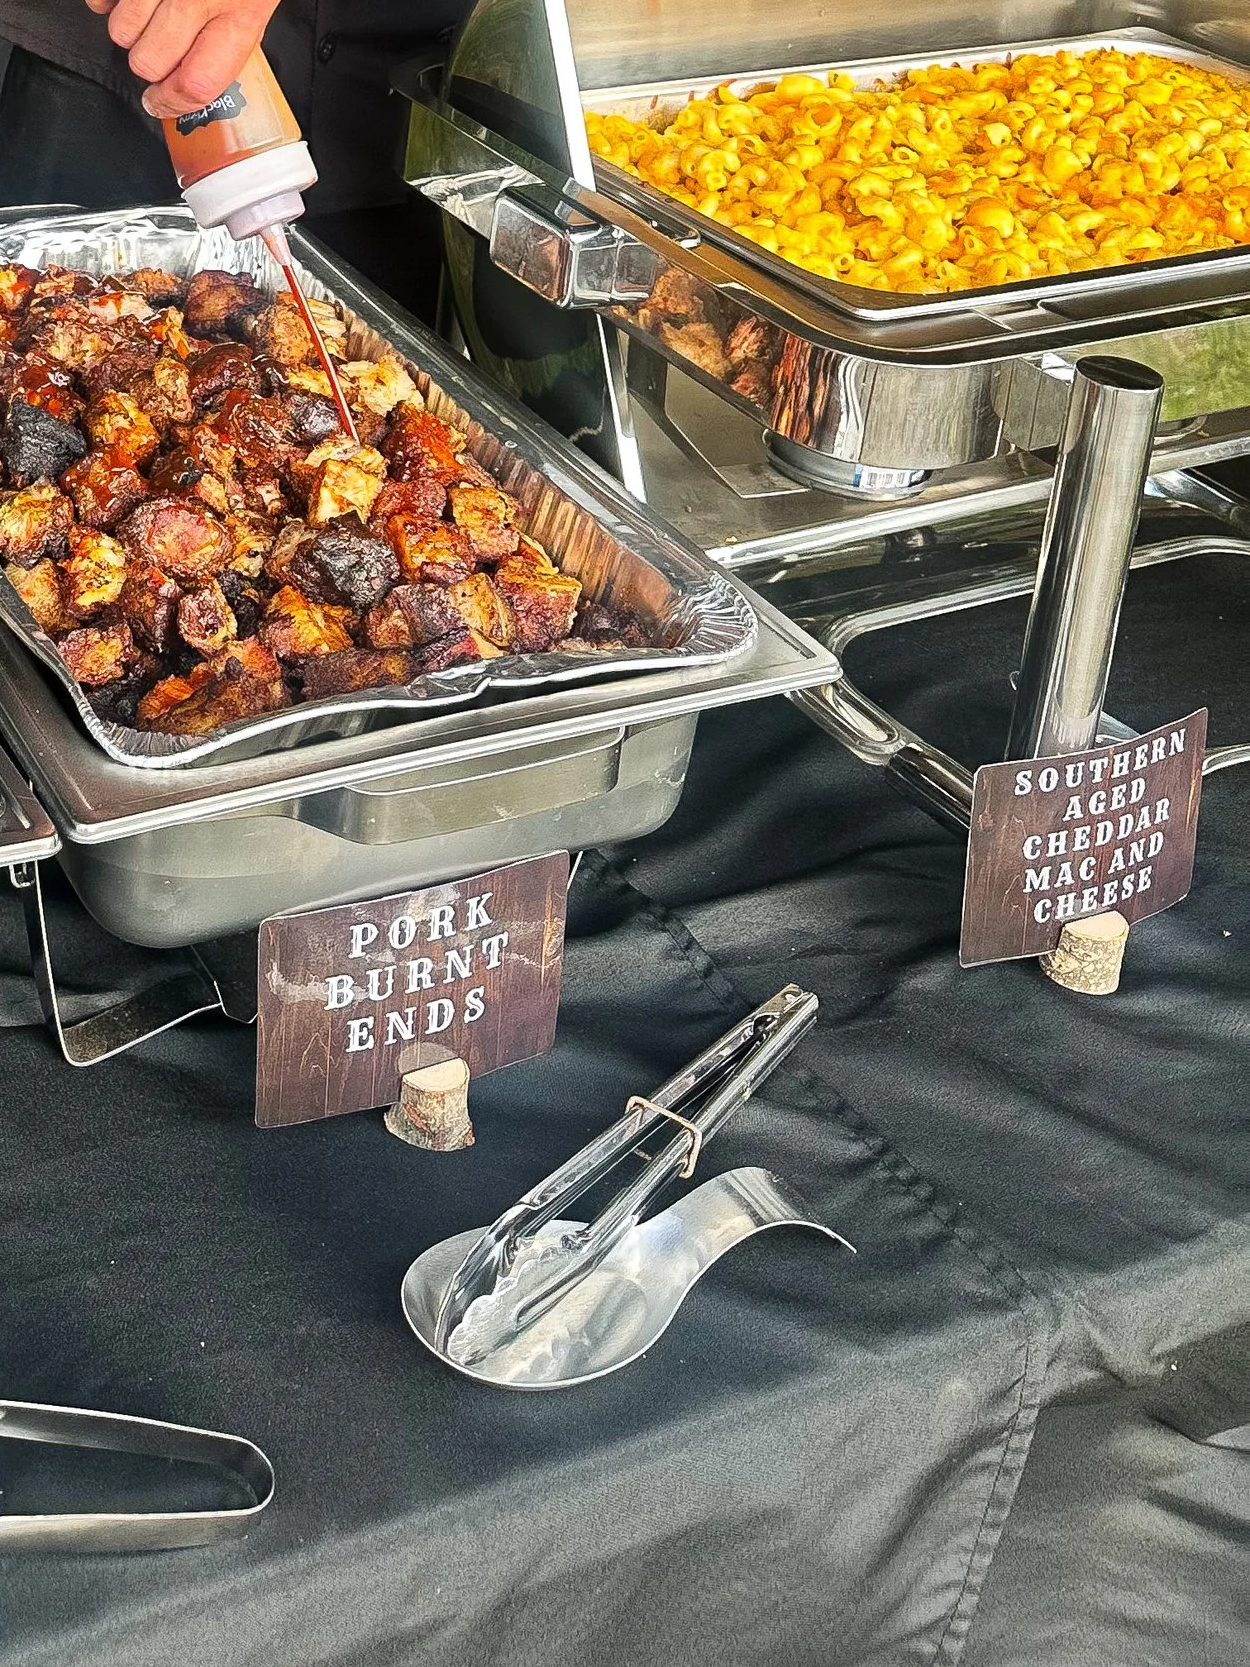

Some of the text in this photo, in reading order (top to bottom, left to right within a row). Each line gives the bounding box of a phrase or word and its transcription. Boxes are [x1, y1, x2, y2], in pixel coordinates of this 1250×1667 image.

[1014, 728, 1187, 797] SOUTHERN
[1022, 797, 1171, 861] CHEDDAR
[1062, 777, 1146, 822] AGED
[1022, 831, 1165, 894] MAC AND
[1033, 865, 1153, 924] CHEESE
[348, 892, 494, 959] PORK
[323, 931, 509, 1011] BURNT
[345, 986, 486, 1053] ENDS
